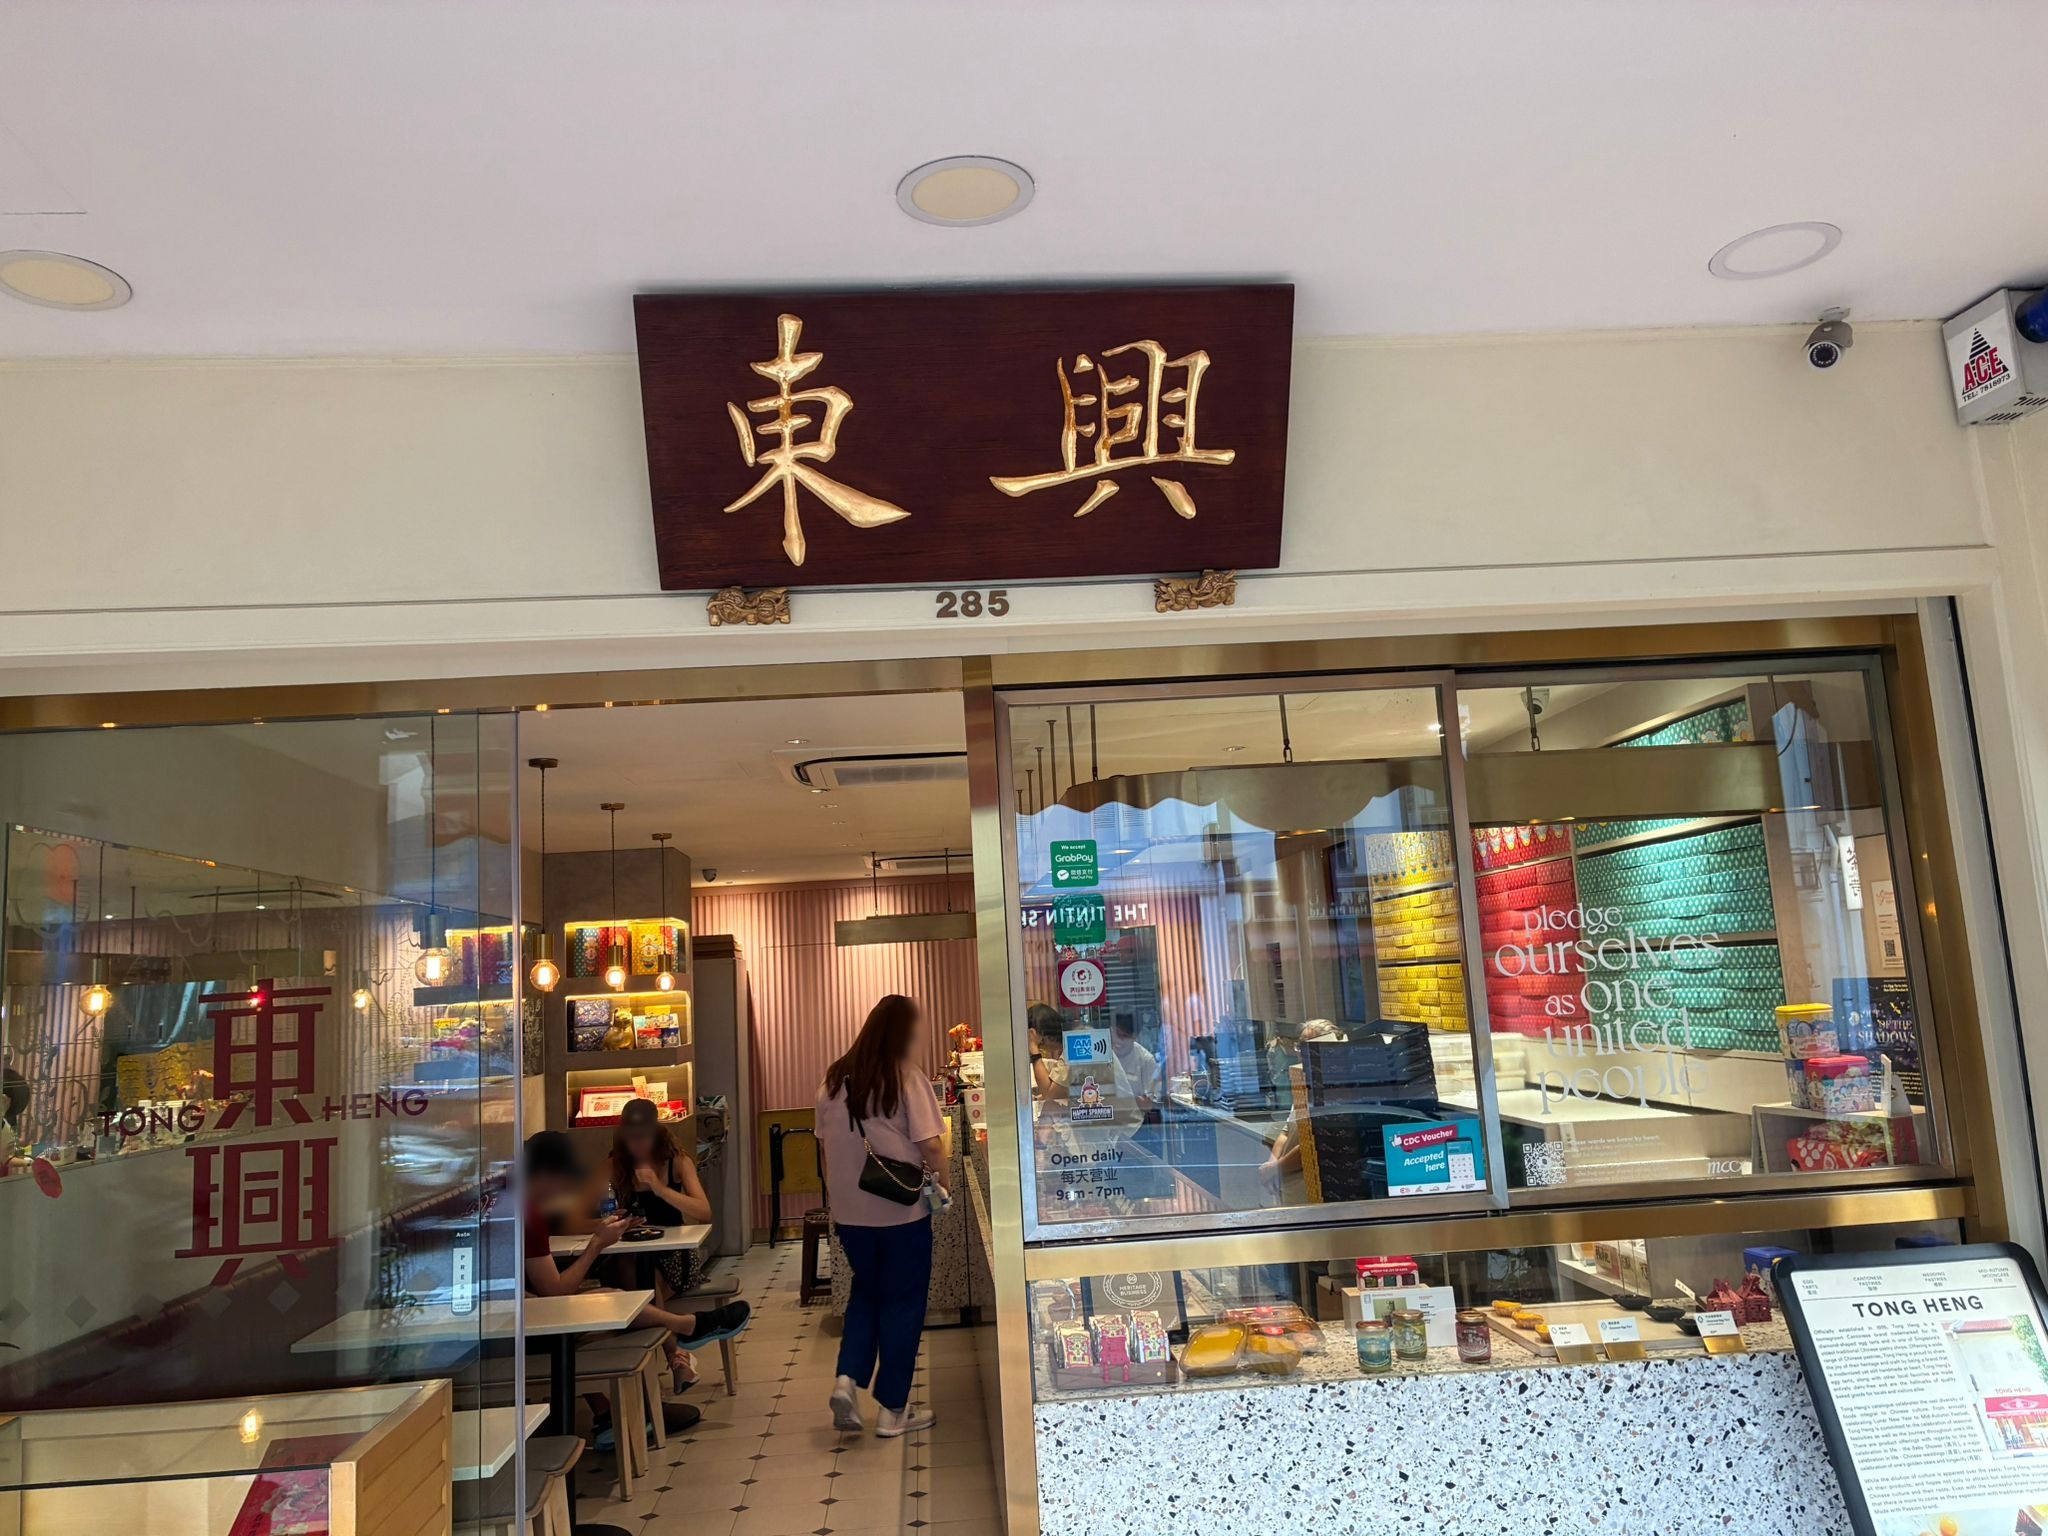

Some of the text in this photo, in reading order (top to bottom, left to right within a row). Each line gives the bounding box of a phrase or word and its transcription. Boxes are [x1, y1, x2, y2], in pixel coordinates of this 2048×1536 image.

[1964, 347, 2002, 391] ACE
[935, 591, 1010, 618] 285
[1055, 853, 1094, 863] GrabPay
[1523, 902, 1623, 938] pledge
[1495, 927, 1725, 977] ourselves
[1545, 975, 1673, 1016] as one
[1543, 1006, 1695, 1058] united
[1858, 1031, 1916, 1043] SHADOWS
[1074, 1039, 1092, 1049] AM
[1077, 1048, 1092, 1057] EX
[1537, 1050, 1708, 1115] people
[97, 1089, 429, 1137] TONG HENG
[1073, 1109, 1088, 1117] HAPPY
[175, 978, 346, 1286] 東興
[1403, 1129, 1453, 1146] CDC Voucher
[1051, 1148, 1124, 1167] Open daily
[1404, 1150, 1444, 1167] Accepted
[1425, 1161, 1446, 1173] here
[1060, 1167, 1118, 1184] 每天营业
[1056, 1189, 1085, 1200] 9am
[1095, 1186, 1125, 1199] 7pm
[1852, 1295, 1984, 1318] TONG HENG
